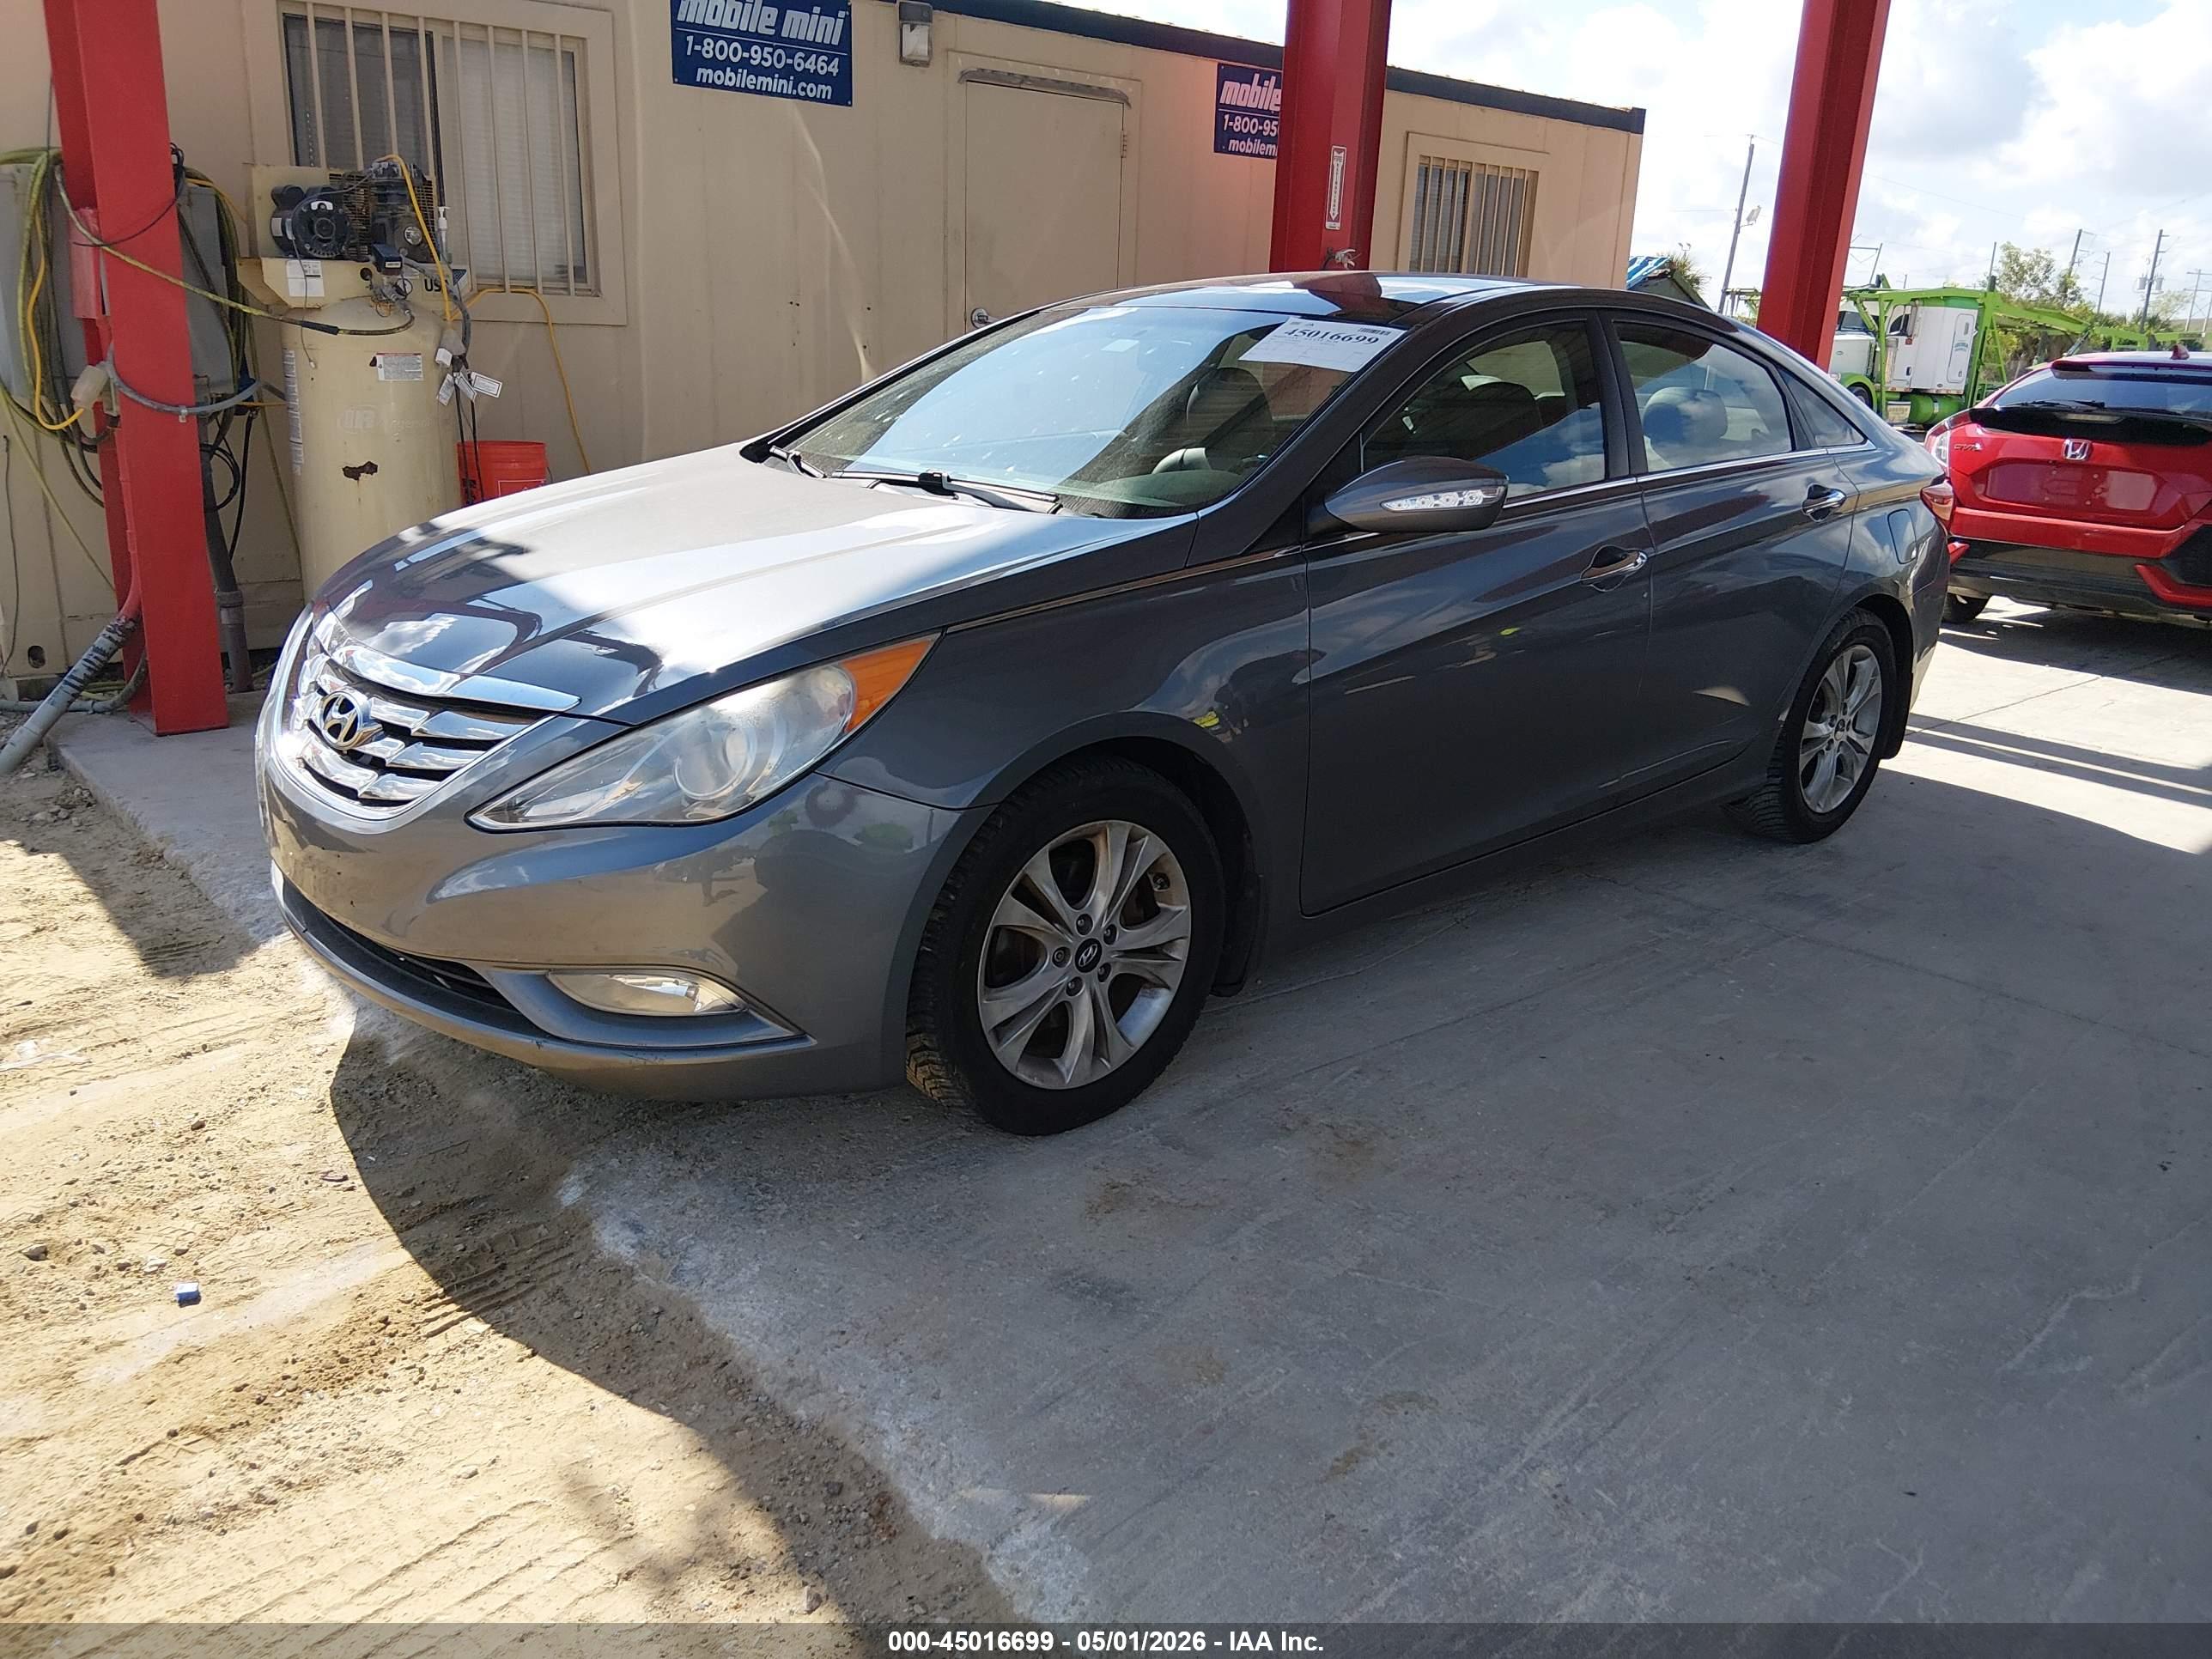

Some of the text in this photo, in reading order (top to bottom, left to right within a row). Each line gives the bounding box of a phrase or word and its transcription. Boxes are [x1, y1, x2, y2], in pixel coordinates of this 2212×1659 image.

[677, 0, 846, 46] mobile mini
[686, 35, 840, 77] 1-800-950-6464
[696, 66, 833, 100] mobilemini.com
[1223, 113, 1279, 137] 1-800-95
[1284, 326, 1380, 345] 45016699
